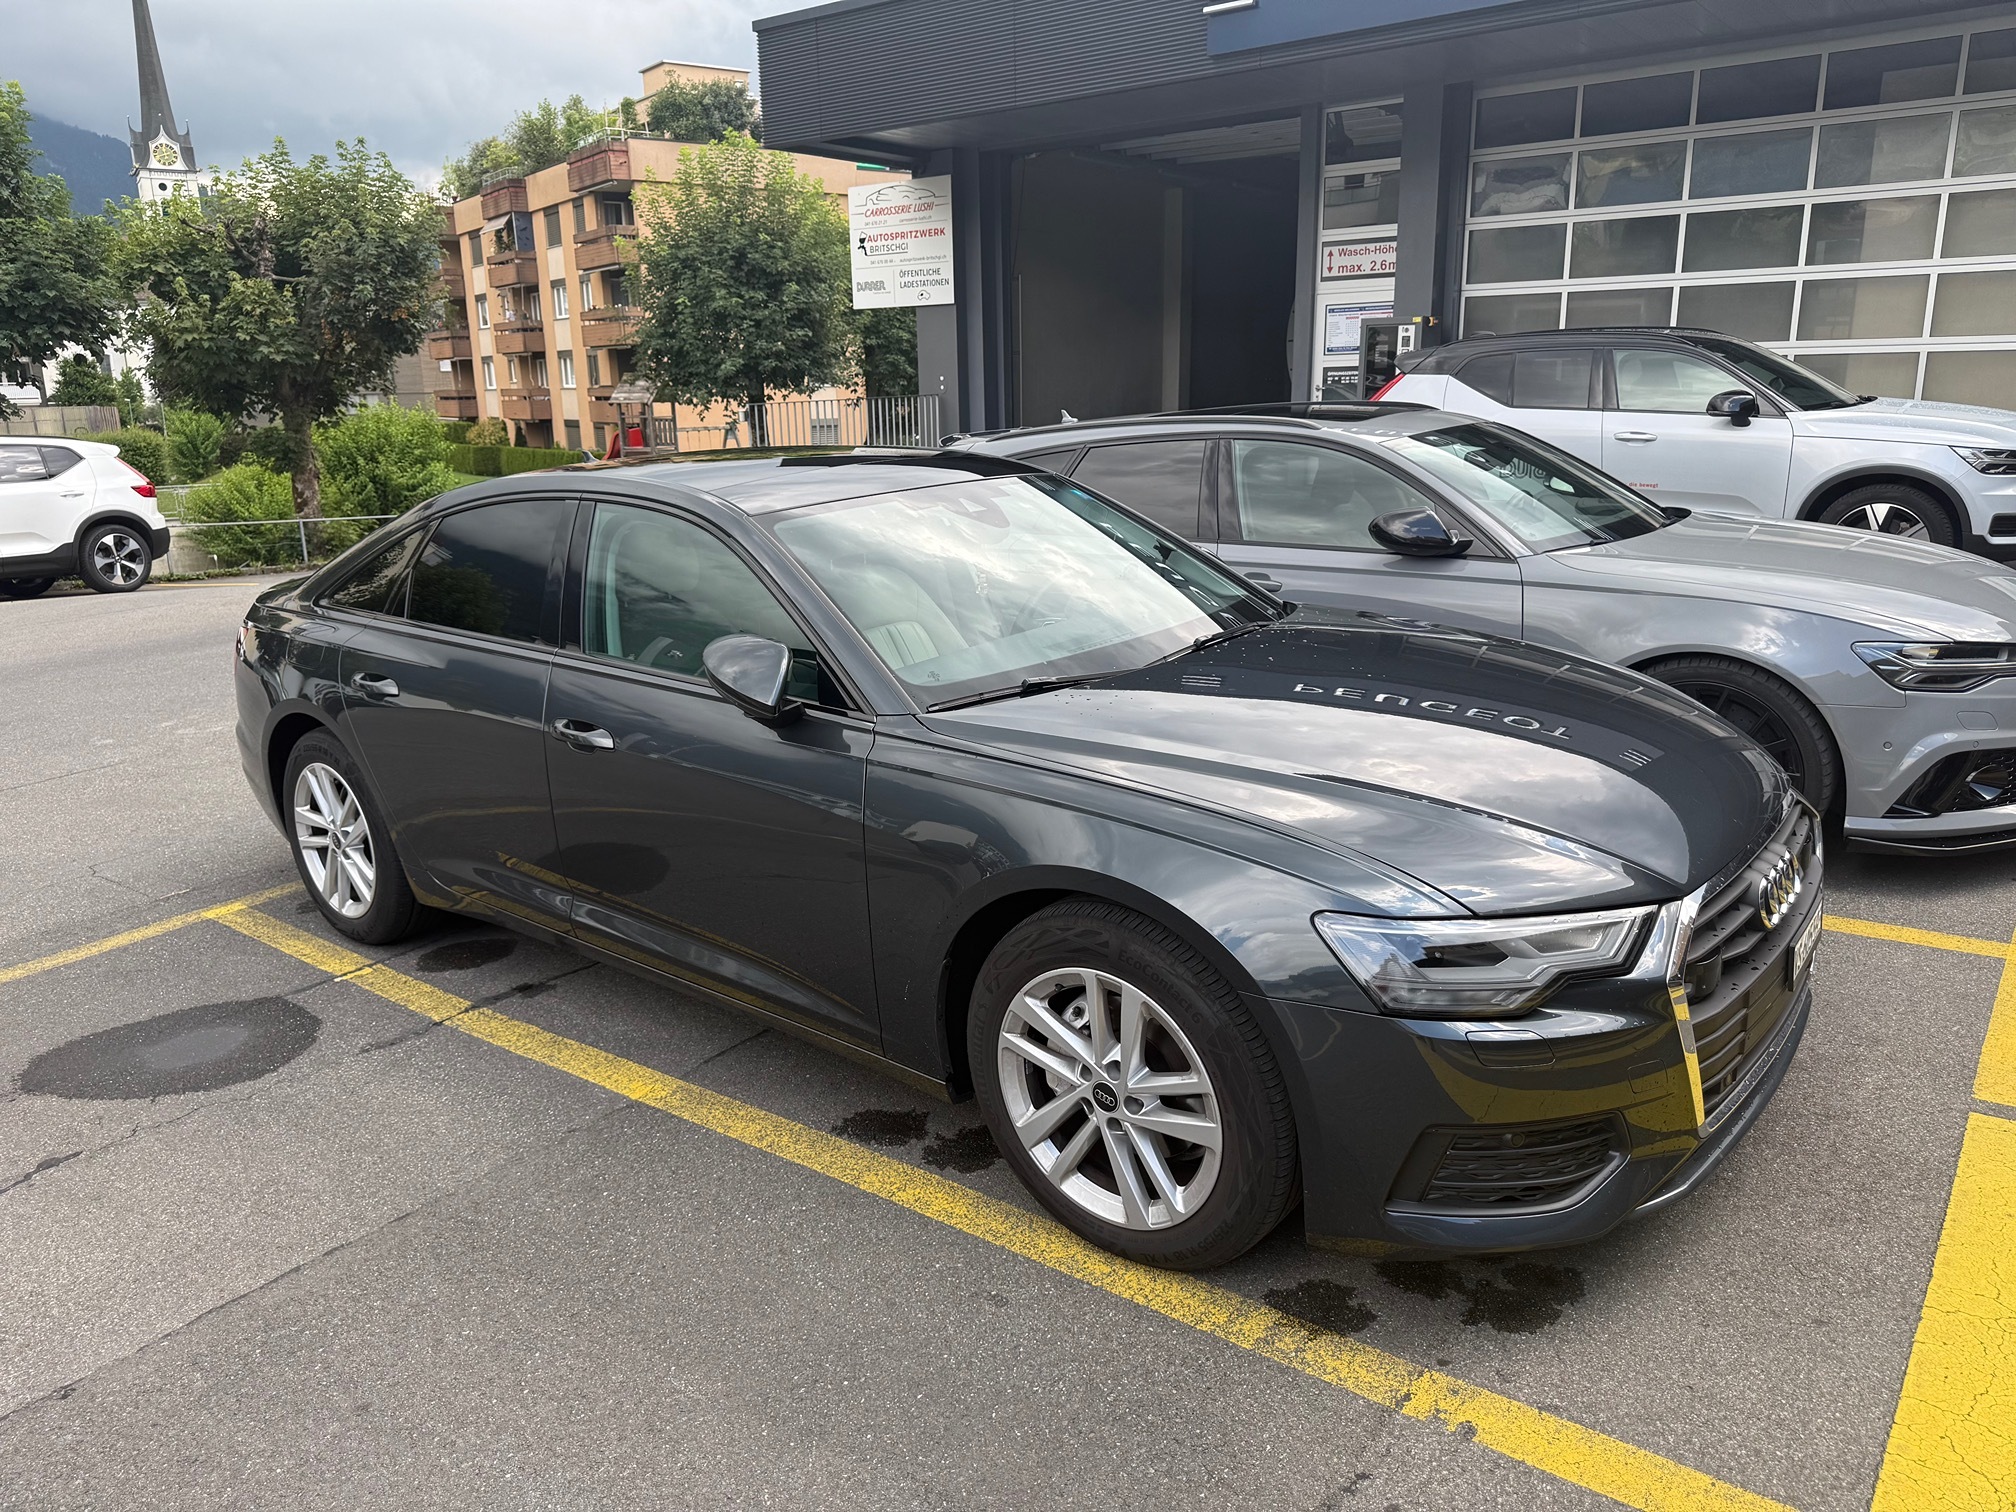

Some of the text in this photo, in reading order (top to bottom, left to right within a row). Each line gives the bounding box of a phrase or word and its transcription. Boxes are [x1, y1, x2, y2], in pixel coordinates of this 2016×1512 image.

[864, 202, 935, 218] CARROSSERIE LUSHI
[867, 227, 946, 243] AUTOSPRITZWERK
[869, 242, 909, 254] BRITSCHGI
[899, 267, 941, 279] ÖFFENTLICHE
[1338, 264, 1366, 274] max.
[899, 278, 950, 289] LADESTATIONEN
